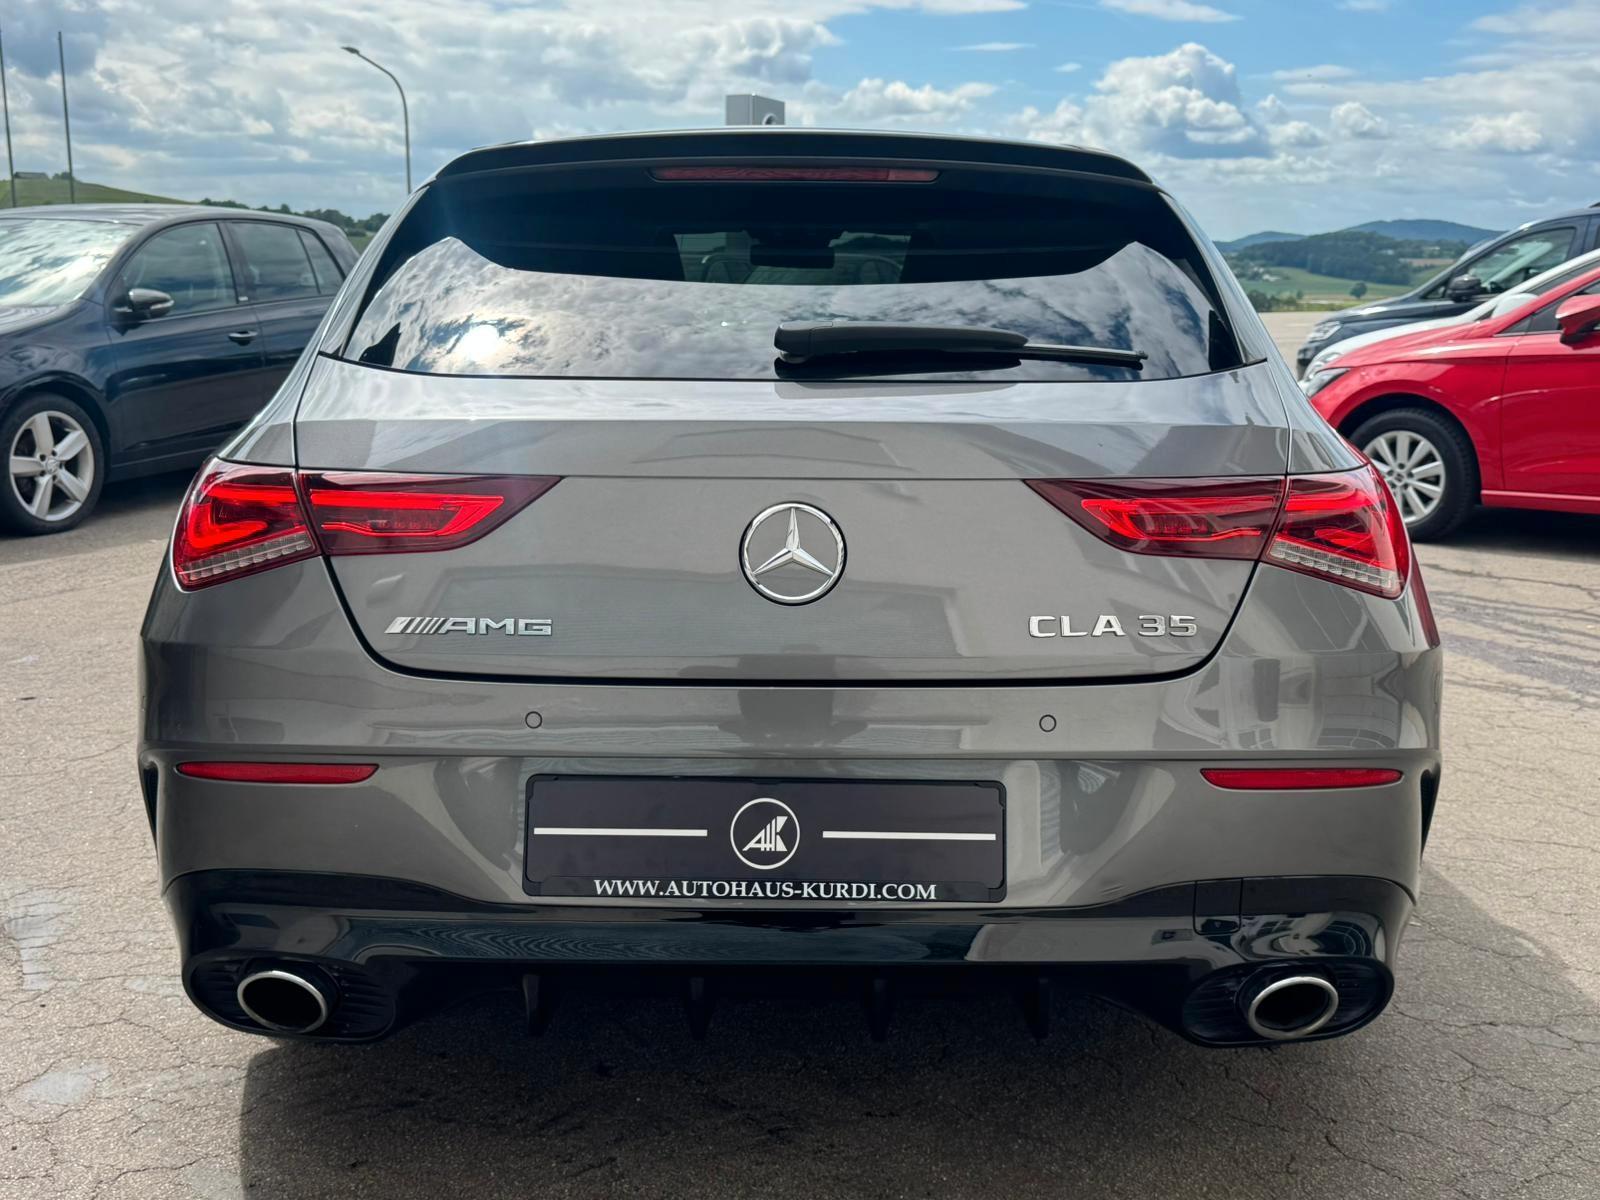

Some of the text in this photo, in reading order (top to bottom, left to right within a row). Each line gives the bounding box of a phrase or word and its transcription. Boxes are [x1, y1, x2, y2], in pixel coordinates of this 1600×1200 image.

[437, 616, 553, 636] AMG
[1028, 614, 1198, 638] CLA 35
[594, 879, 937, 900] WWW.AUTOHAUS-KURDI.COM
